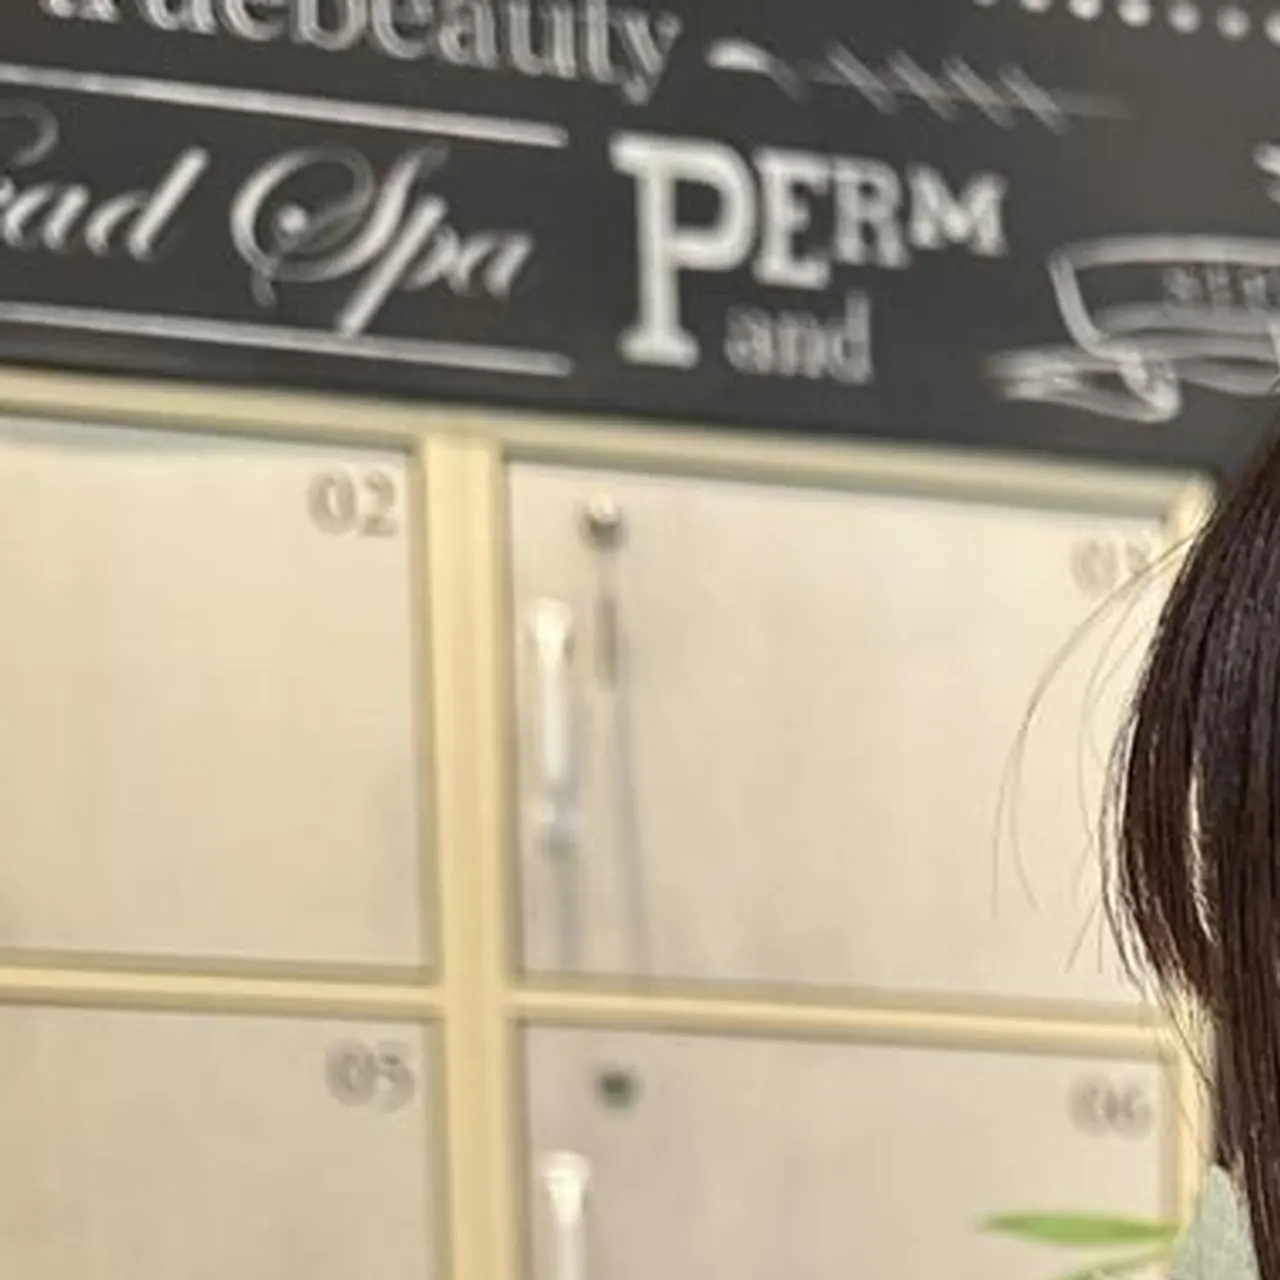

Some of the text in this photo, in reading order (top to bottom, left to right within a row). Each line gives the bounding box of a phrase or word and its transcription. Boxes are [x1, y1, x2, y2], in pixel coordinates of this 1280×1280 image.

[230, 145, 534, 338] Spa
[607, 130, 1009, 370] PERM
[723, 290, 874, 384] and
[303, 470, 400, 540] 02
